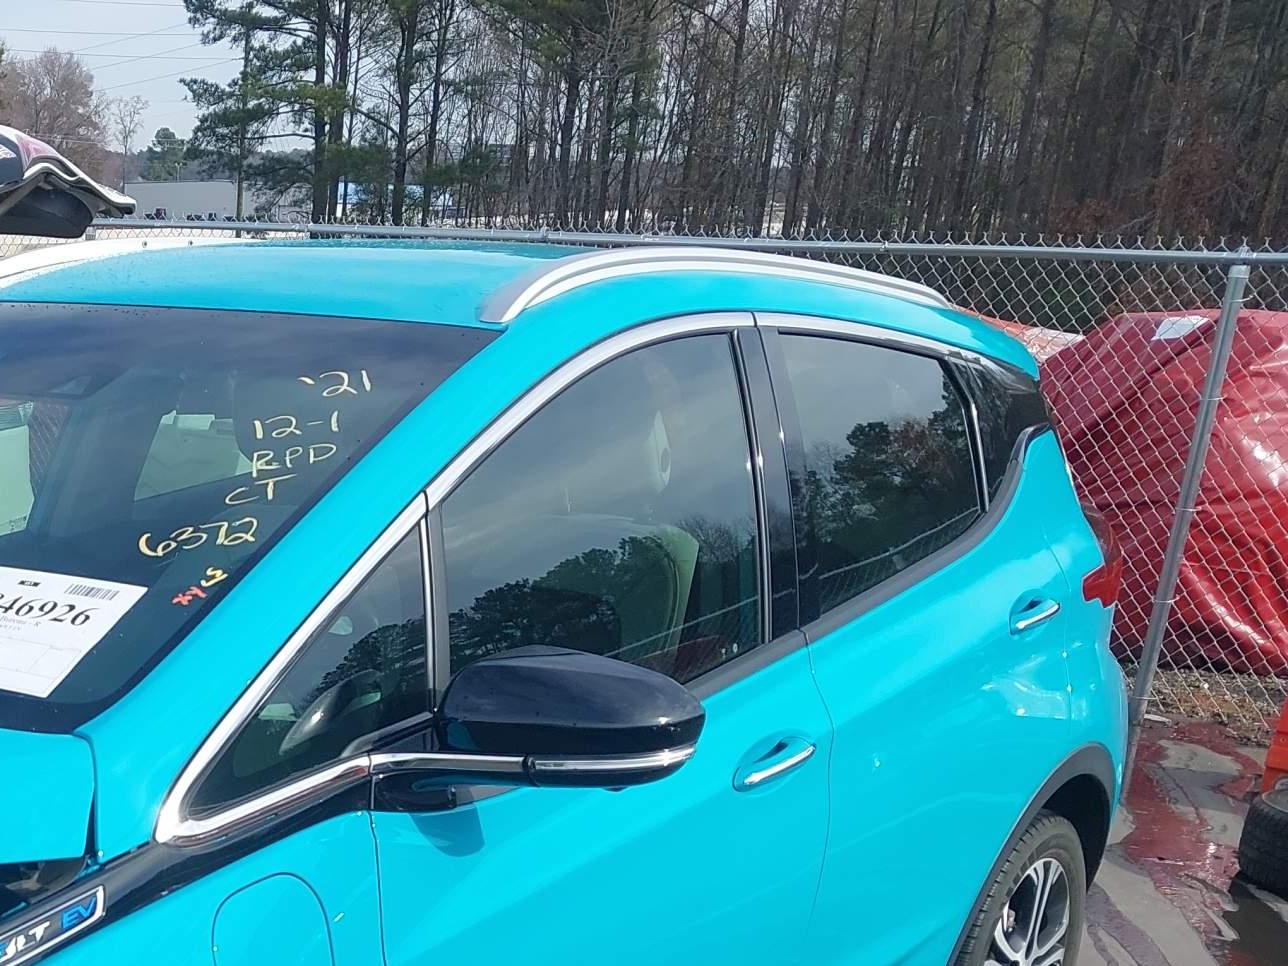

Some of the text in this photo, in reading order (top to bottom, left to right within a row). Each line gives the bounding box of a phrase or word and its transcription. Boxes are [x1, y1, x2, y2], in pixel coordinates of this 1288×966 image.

[253, 410, 340, 440] 12-1
[252, 443, 338, 478] RPD
[224, 473, 298, 505] CT
[138, 516, 259, 557] 6372
[62, 896, 98, 930] EV
